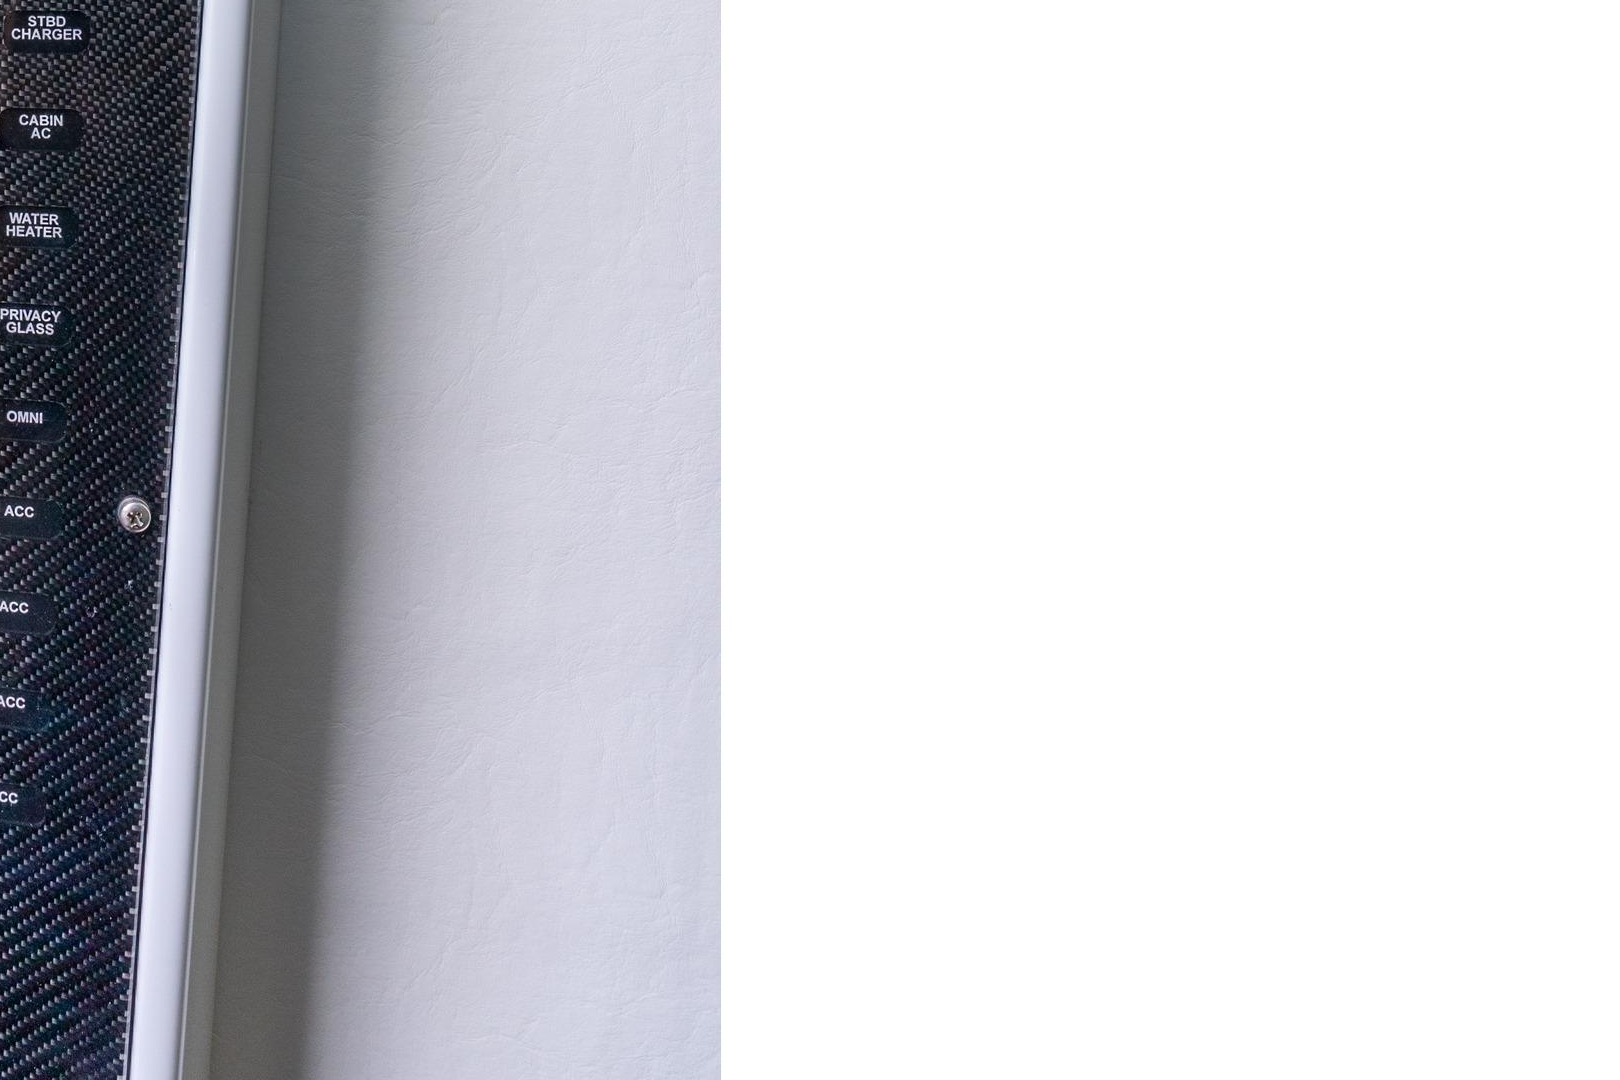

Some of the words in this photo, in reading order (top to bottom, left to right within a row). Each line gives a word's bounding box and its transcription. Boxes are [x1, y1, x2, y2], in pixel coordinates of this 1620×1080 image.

[28, 15, 66, 27] STBD
[11, 28, 82, 41] CHARGER
[19, 114, 64, 127] CABIN
[30, 128, 51, 140] AC
[9, 212, 59, 226] WATER
[6, 225, 62, 238] HEATER
[0, 309, 61, 323] PRIVACY
[6, 322, 54, 335] GLASS
[6, 411, 43, 424] OMNI
[4, 505, 34, 518] ACC
